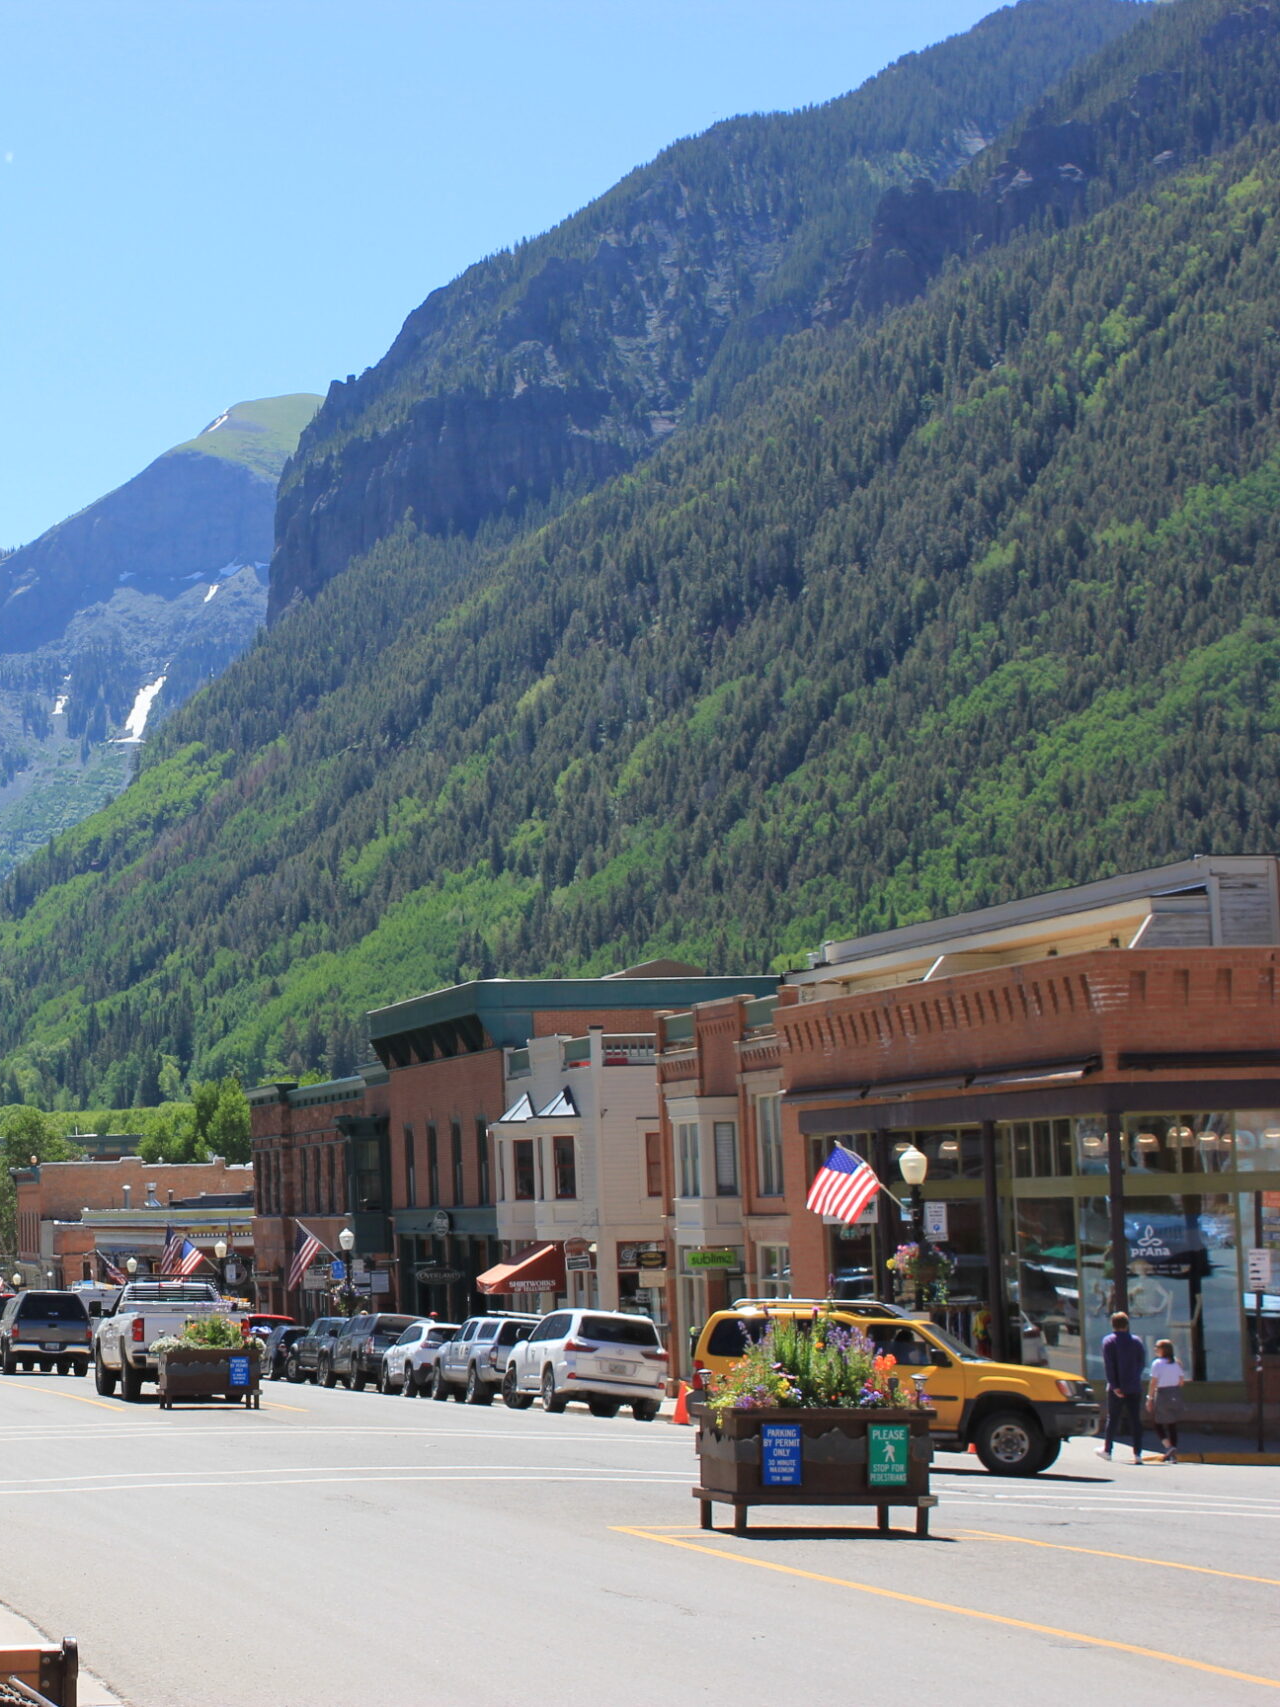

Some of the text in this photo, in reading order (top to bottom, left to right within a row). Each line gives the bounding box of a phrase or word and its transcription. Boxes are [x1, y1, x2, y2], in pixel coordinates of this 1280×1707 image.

[1130, 1247, 1170, 1258] prAna
[508, 1280, 556, 1288] SHIRTWORKS
[767, 1429, 796, 1437] PARKING
[873, 1430, 905, 1440] PLEASE
[763, 1439, 800, 1447] BY PERMIT
[773, 1448, 790, 1457] ONLY
[873, 1464, 904, 1472] STOP FOR
[870, 1474, 907, 1482] PEDESTRIANS
